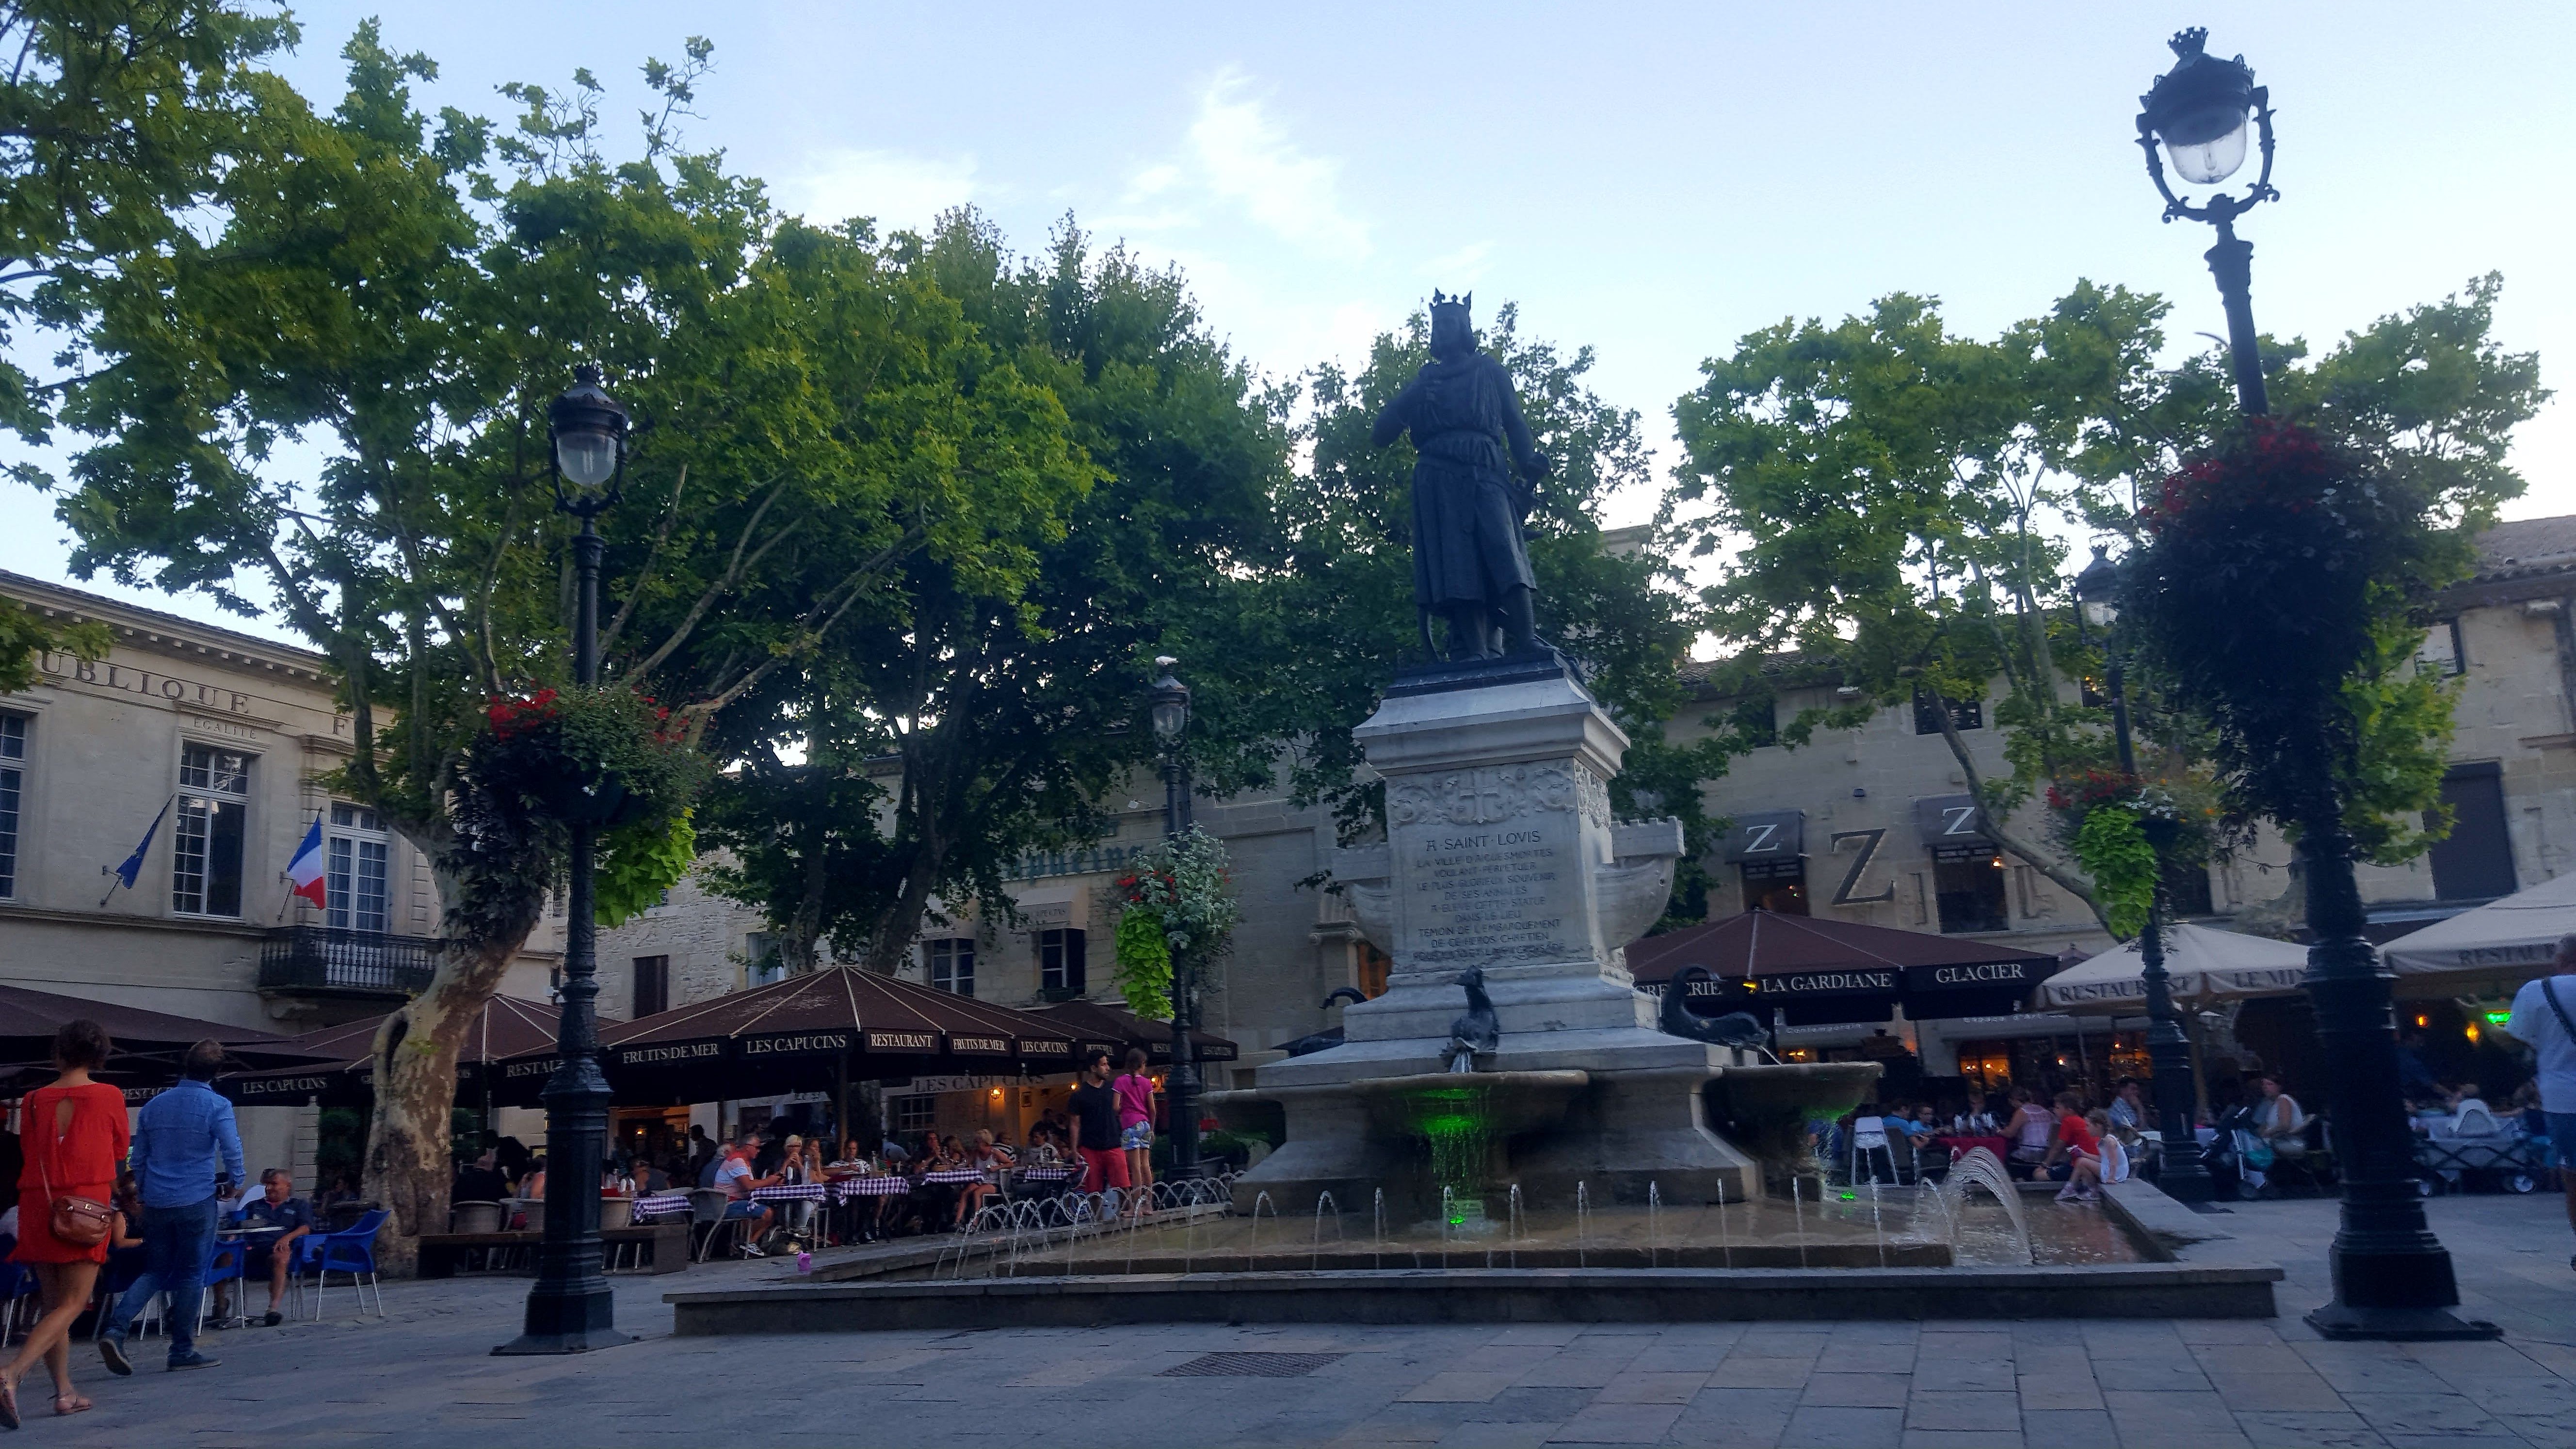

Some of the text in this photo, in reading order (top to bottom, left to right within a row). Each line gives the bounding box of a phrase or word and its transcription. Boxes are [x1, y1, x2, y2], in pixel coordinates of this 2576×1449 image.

[40, 652, 249, 714] UBLIQUE
[1942, 806, 1976, 836] Z
[1444, 835, 1489, 850] SAINT
[1497, 830, 1541, 845] LOVIS
[1744, 824, 1779, 853] Z
[1434, 856, 1462, 866] VILLE
[1830, 828, 1896, 906] Z
[1762, 973, 1894, 993] LA GARDIANE
[1935, 963, 2025, 983] GLACIER
[746, 1034, 847, 1053] LES CAPUCINS
[870, 1033, 933, 1047] RESTAURANT
[622, 1043, 719, 1064] FRUITS DE MER
[242, 1081, 265, 1094] LES
[915, 1078, 946, 1092] LES
